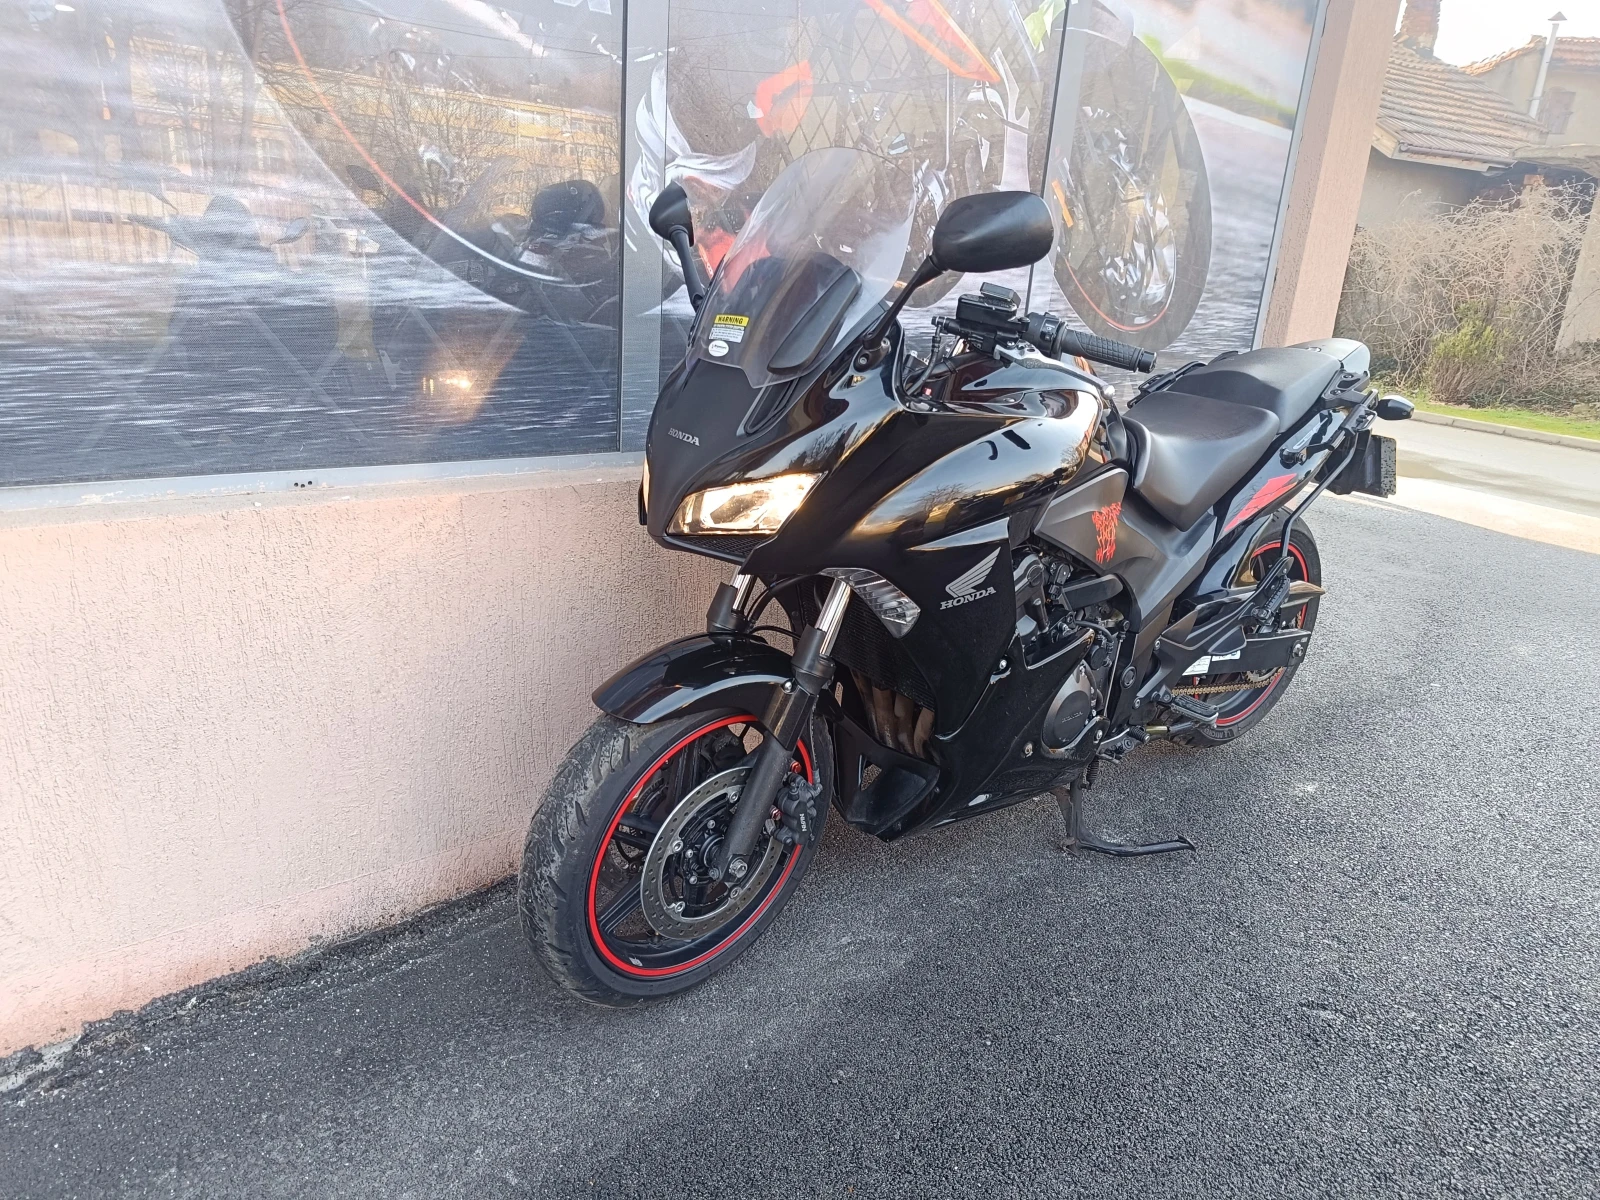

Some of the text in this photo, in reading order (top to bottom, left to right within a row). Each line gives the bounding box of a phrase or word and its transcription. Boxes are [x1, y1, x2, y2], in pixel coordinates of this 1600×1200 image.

[717, 316, 744, 325] WARNING
[668, 427, 700, 446] HONDA
[940, 586, 997, 610] HONDA
